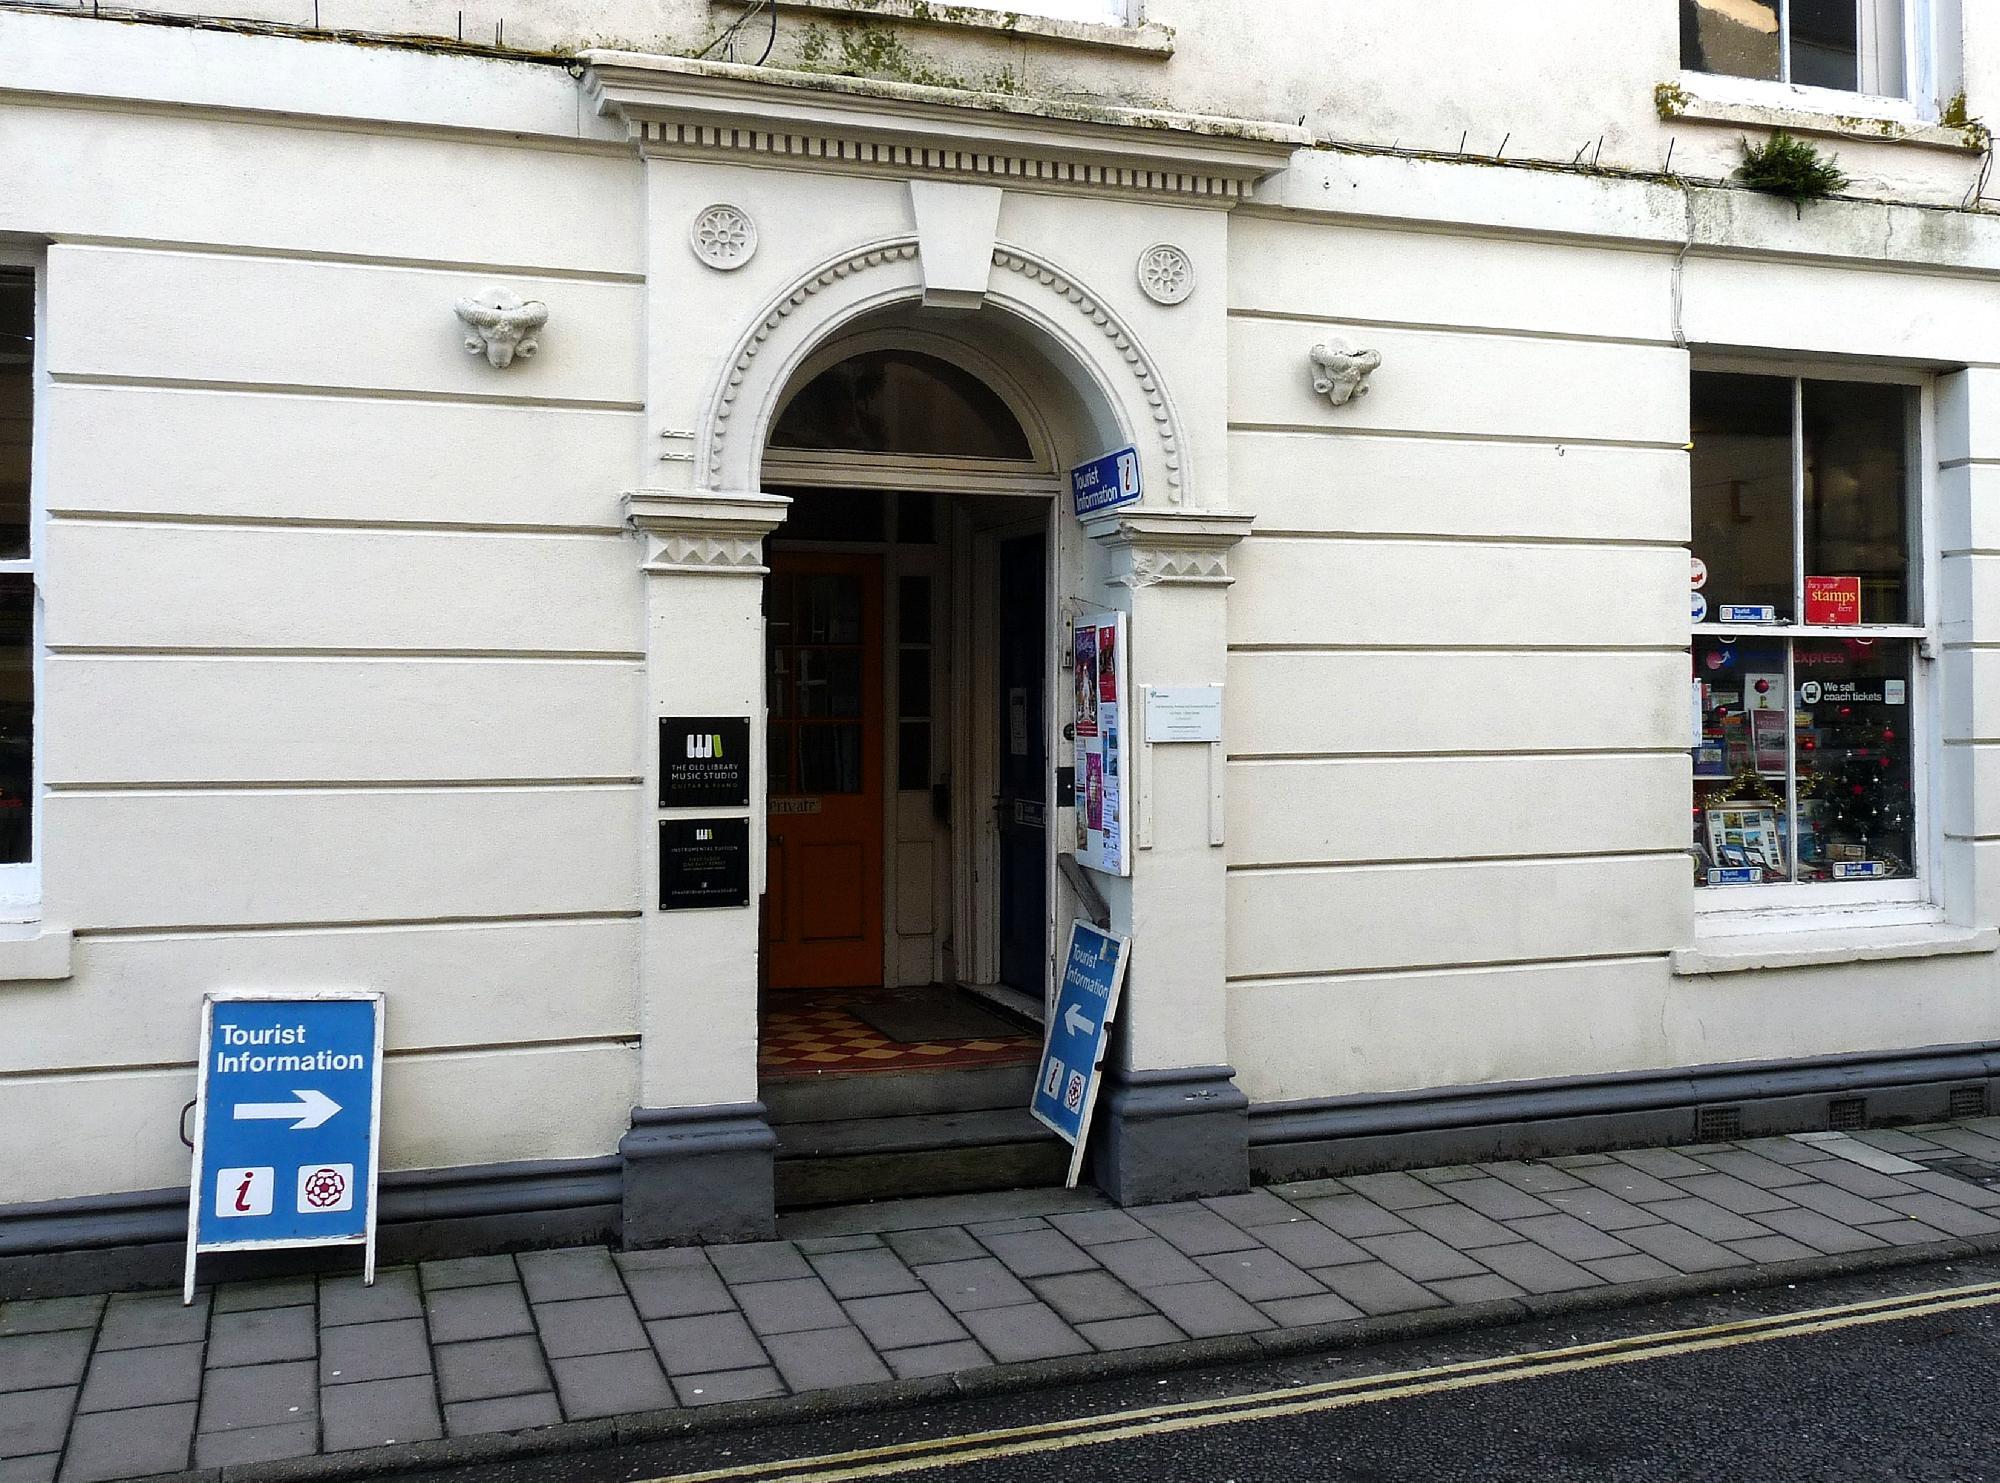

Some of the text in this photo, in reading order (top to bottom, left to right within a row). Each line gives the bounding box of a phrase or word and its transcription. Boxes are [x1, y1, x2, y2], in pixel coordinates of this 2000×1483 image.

[1073, 466, 1099, 490] Tourist
[1075, 483, 1118, 512] Information
[1811, 590, 1856, 606] stamps
[1823, 682, 1856, 692] We sell
[1823, 692, 1882, 701] coach tickets
[672, 763, 738, 772] THE OLD LIBRARY
[672, 771, 738, 781] MUSIC STUDIO
[1072, 943, 1098, 969] Tourist
[1066, 964, 1110, 1001] Information
[220, 1023, 306, 1045] Tourist
[217, 1049, 364, 1073] Information
